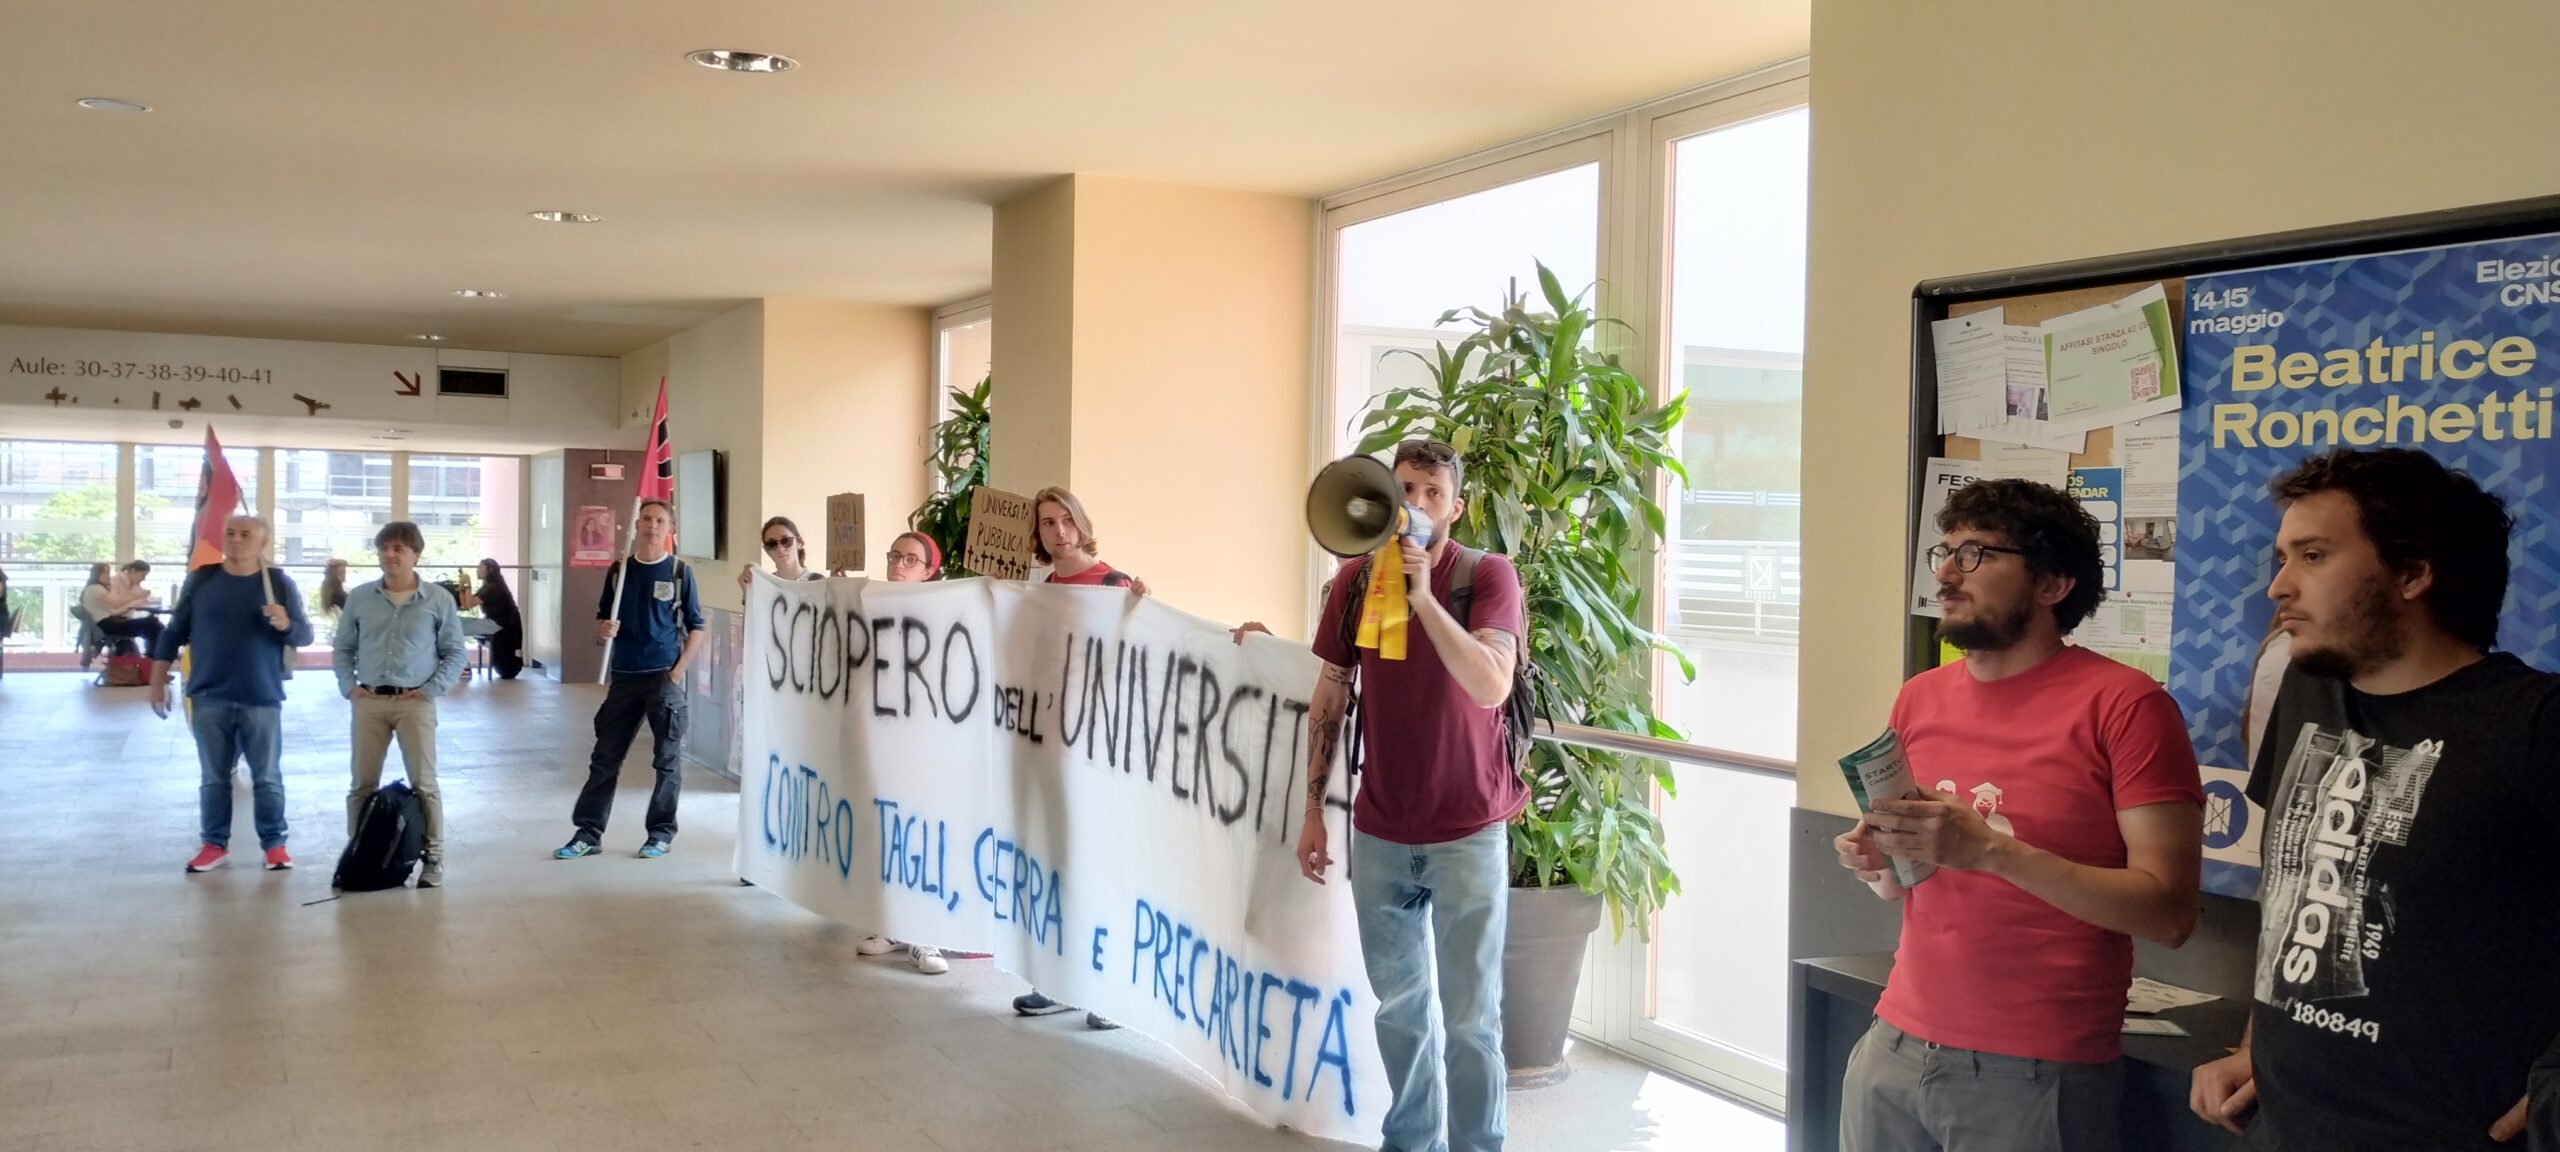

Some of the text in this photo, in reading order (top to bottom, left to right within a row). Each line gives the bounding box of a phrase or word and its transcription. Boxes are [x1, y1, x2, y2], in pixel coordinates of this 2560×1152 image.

[2192, 287, 2249, 312] 14-15
[2095, 328, 2126, 344] STANZA
[2190, 308, 2284, 334] maggio
[2091, 339, 2128, 356] SINGOLO
[2231, 331, 2537, 392] Beatrice
[9, 356, 273, 385] Aule: 30-37-38-39-40-41
[2213, 388, 2554, 449] Ronchetti
[1937, 473, 1981, 487] FES
[976, 521, 1024, 554] PUBBLICA
[766, 592, 981, 724] SCIOPERO
[2382, 810, 2403, 841] EST
[2283, 758, 2367, 985] adidas
[2354, 874, 2365, 895] FOR
[764, 753, 853, 878] CONTRO
[873, 797, 959, 912] TAGLI,
[1093, 927, 1108, 971] E
[1132, 899, 1354, 1117] PRECARIETÀ
[2361, 922, 2385, 960] 1949
